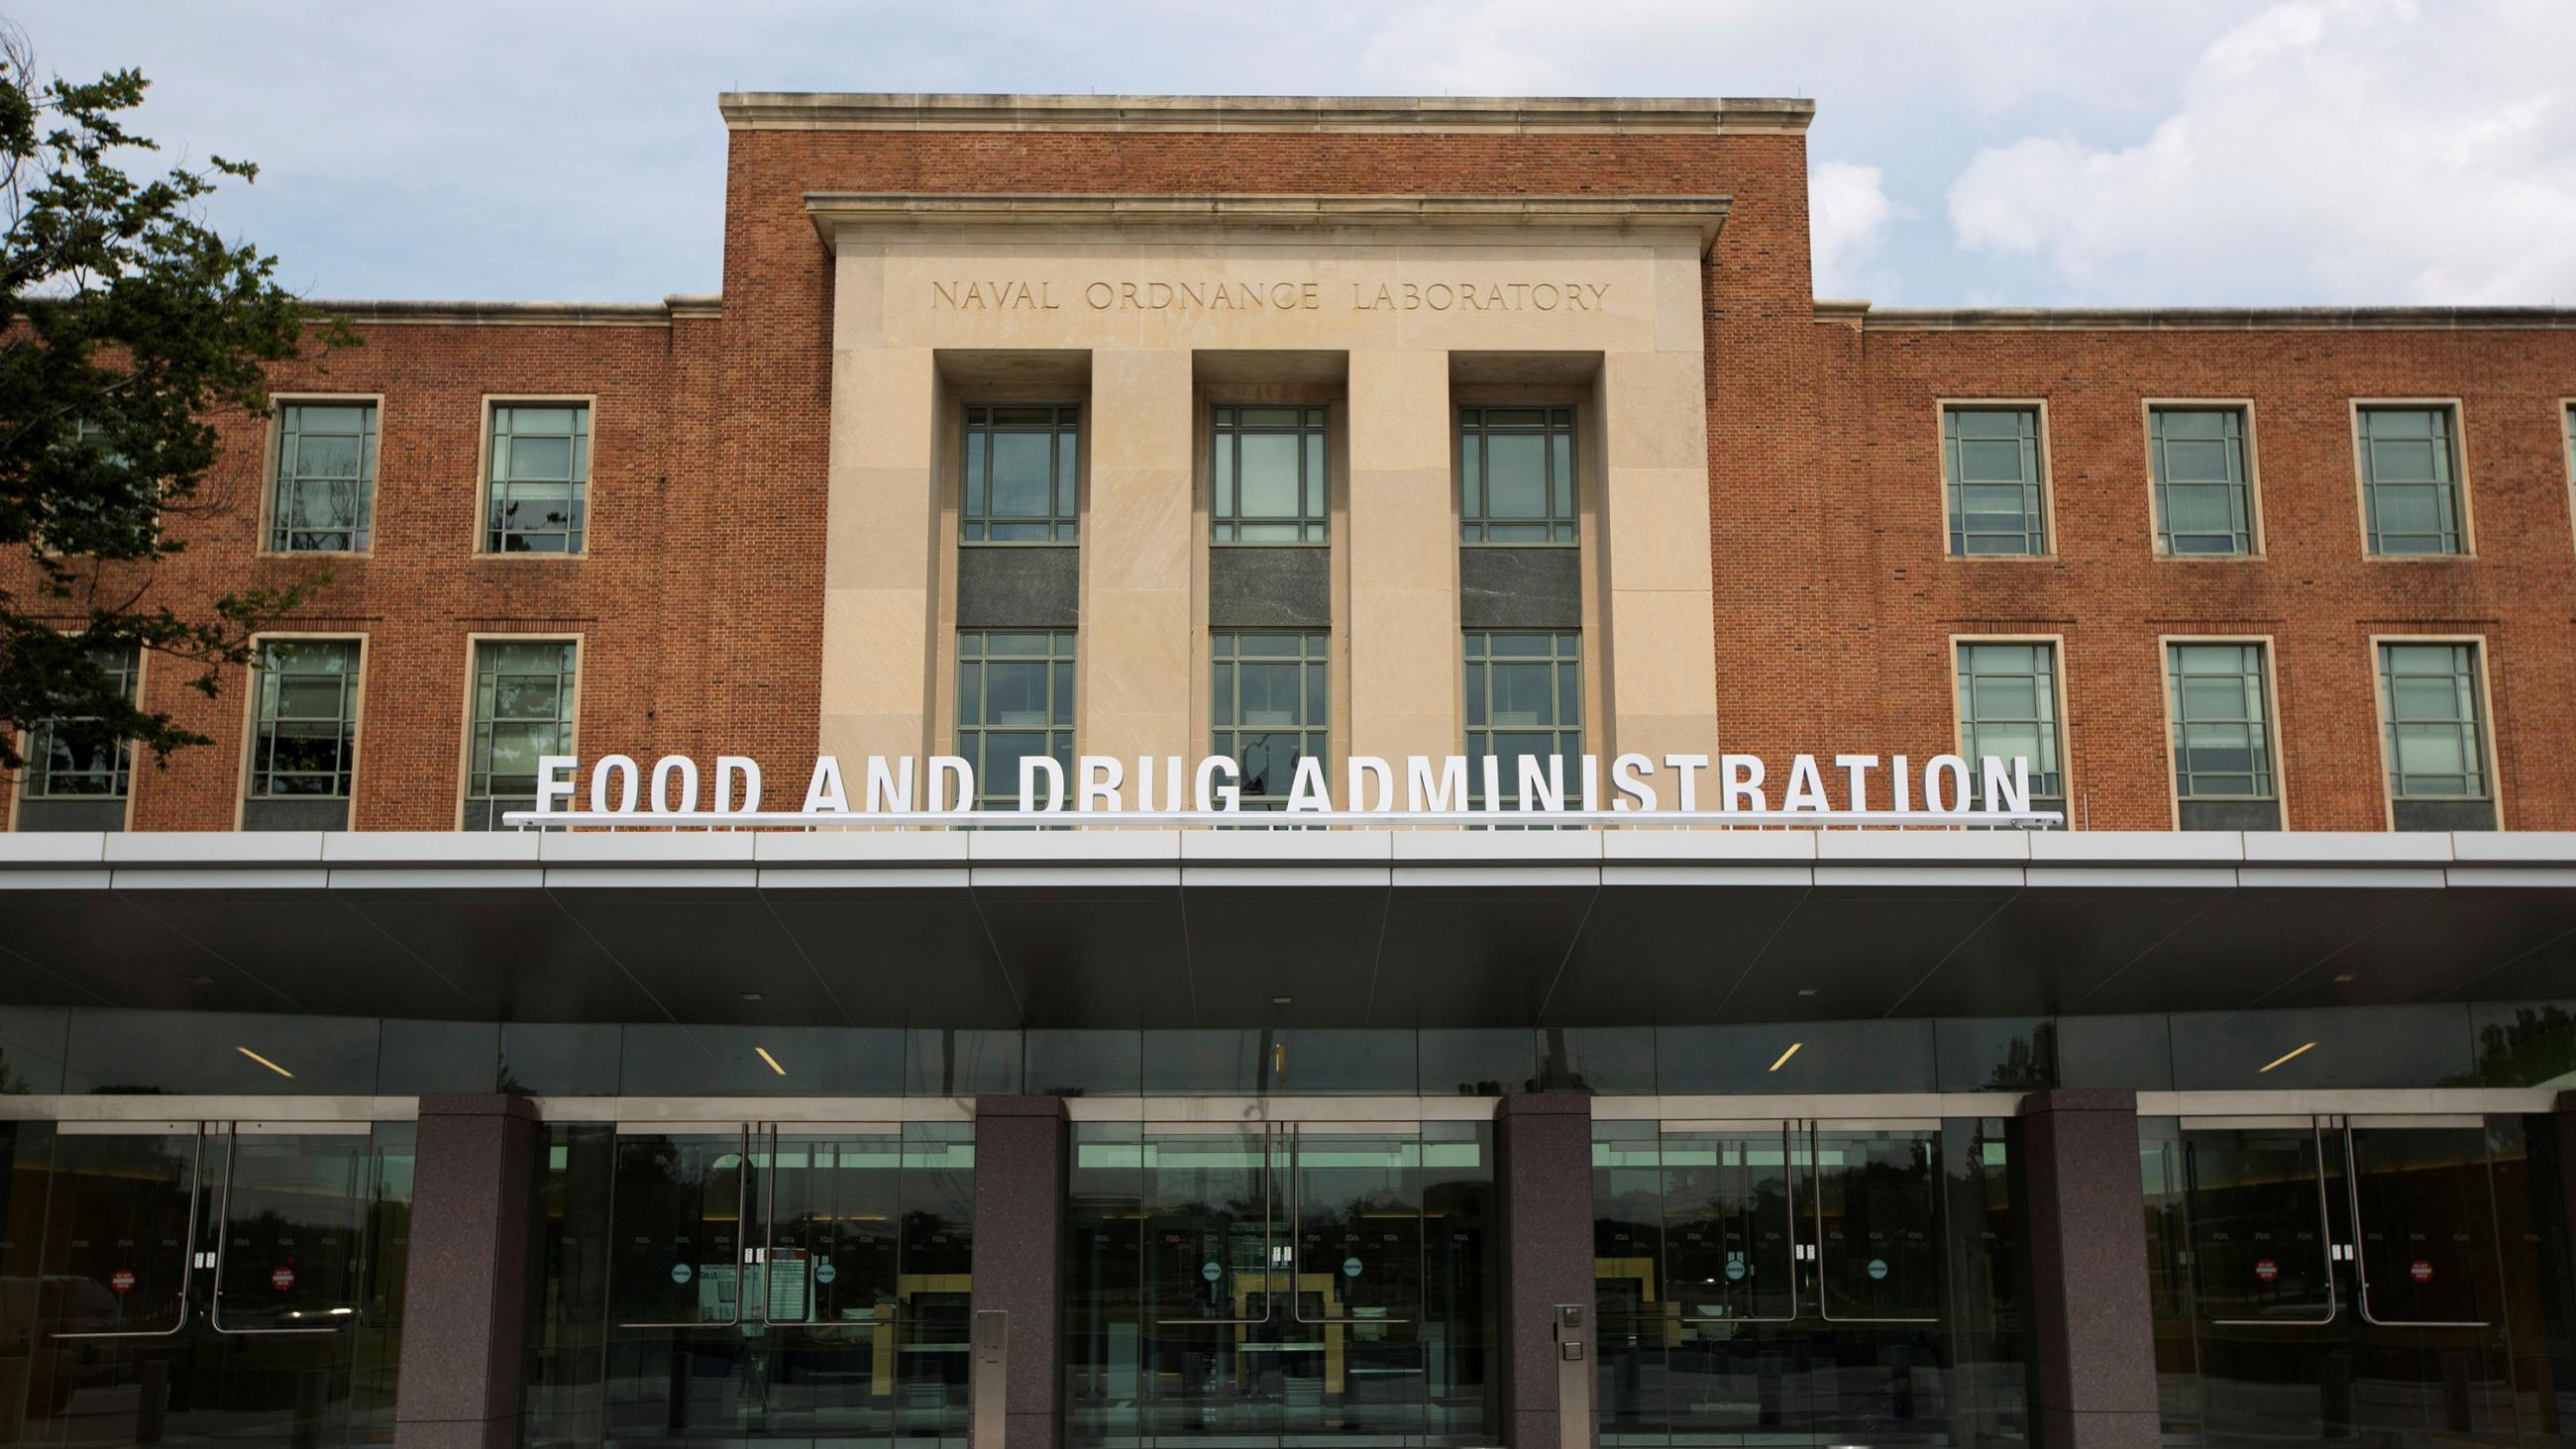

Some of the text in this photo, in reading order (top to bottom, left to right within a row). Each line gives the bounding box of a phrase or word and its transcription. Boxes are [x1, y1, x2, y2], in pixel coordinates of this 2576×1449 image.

[932, 281, 1612, 311] NAVAL ORDNANCE LABORATORY
[536, 753, 2031, 813] FOOD AND DRUG ADMINISTRATION
